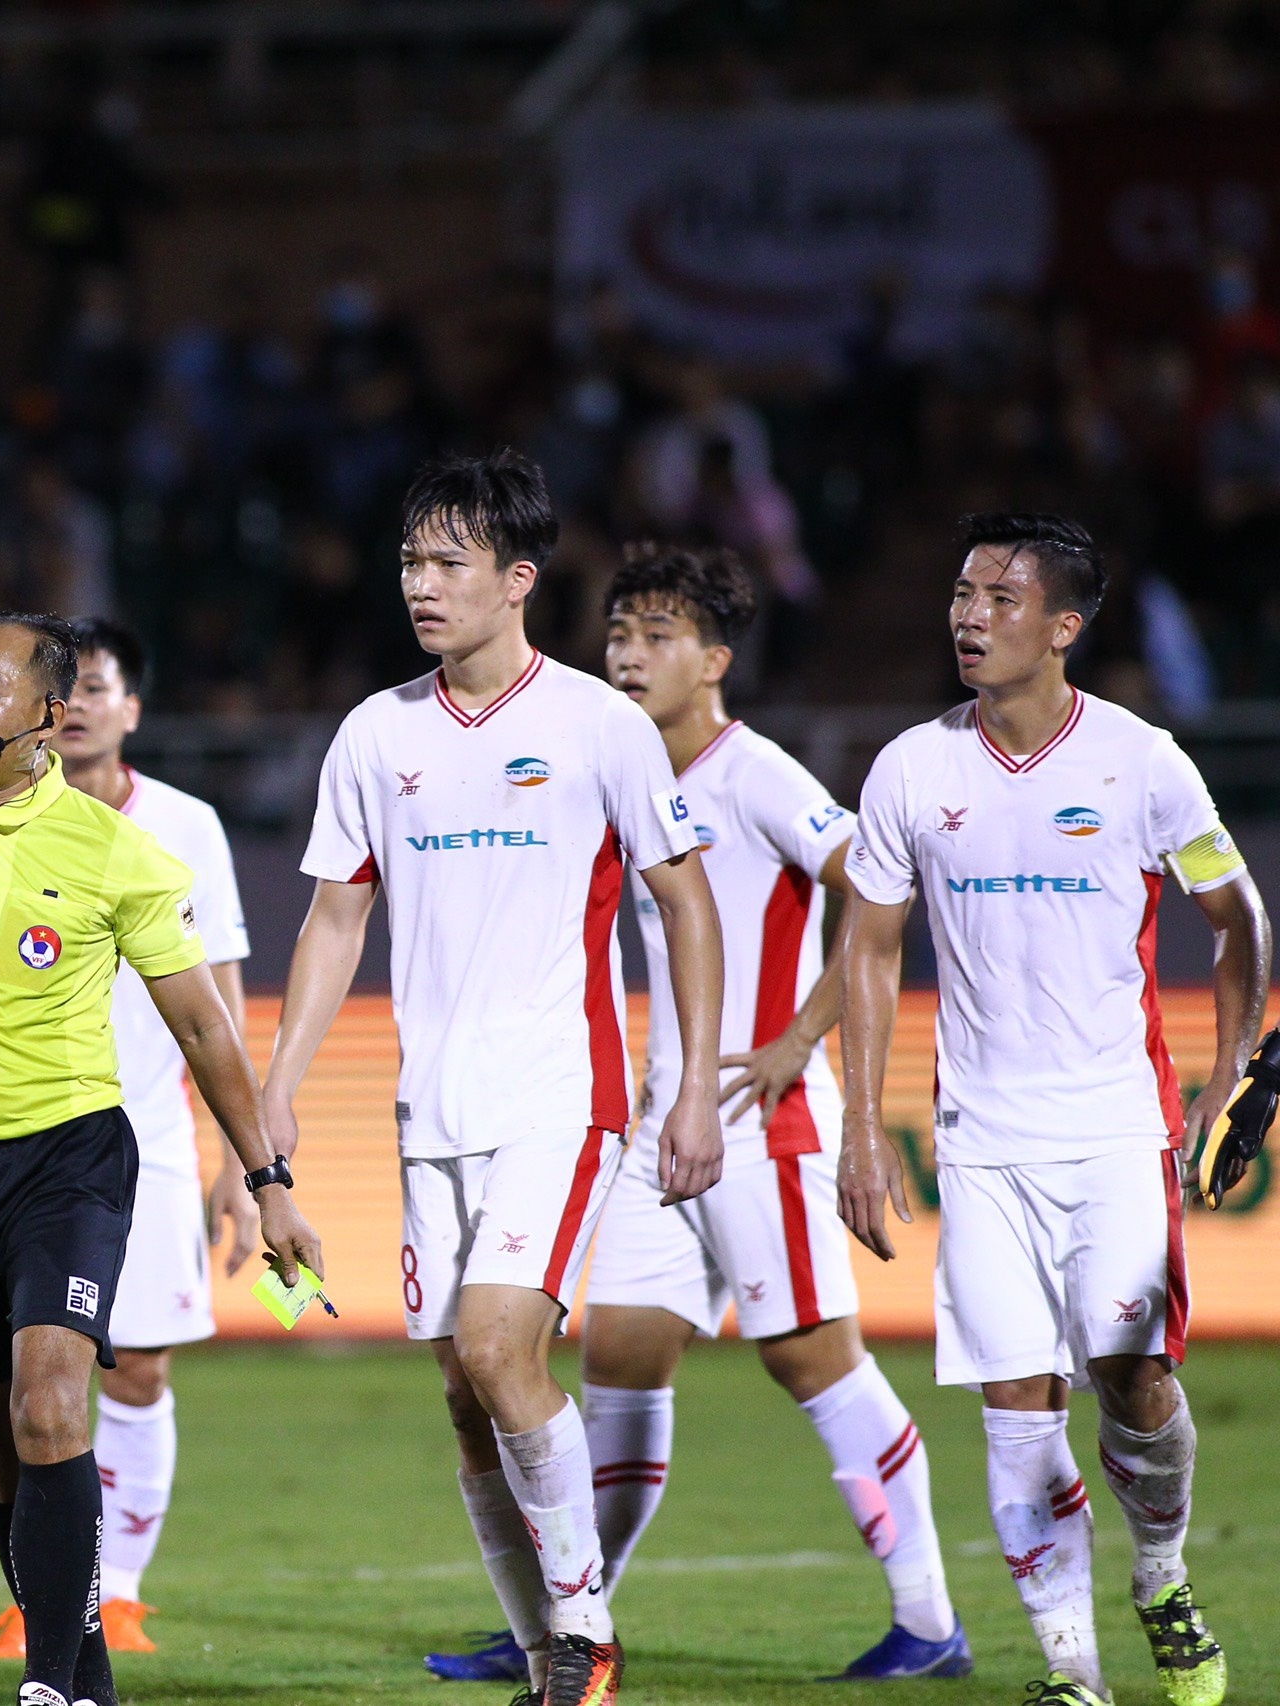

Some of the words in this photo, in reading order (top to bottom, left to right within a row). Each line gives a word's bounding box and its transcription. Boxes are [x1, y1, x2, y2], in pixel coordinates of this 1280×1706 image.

[505, 768, 551, 776] VIETTEL
[397, 785, 421, 796] FBT
[669, 795, 689, 822] LS
[809, 805, 844, 833] LS
[1054, 818, 1103, 826] VIETTEL
[938, 821, 965, 831] FBT
[405, 828, 548, 851] VIETTEL
[946, 874, 1103, 893] VIETTEL
[497, 1243, 526, 1254] FBT
[401, 1244, 422, 1313] 8
[1113, 1312, 1142, 1323] FBT
